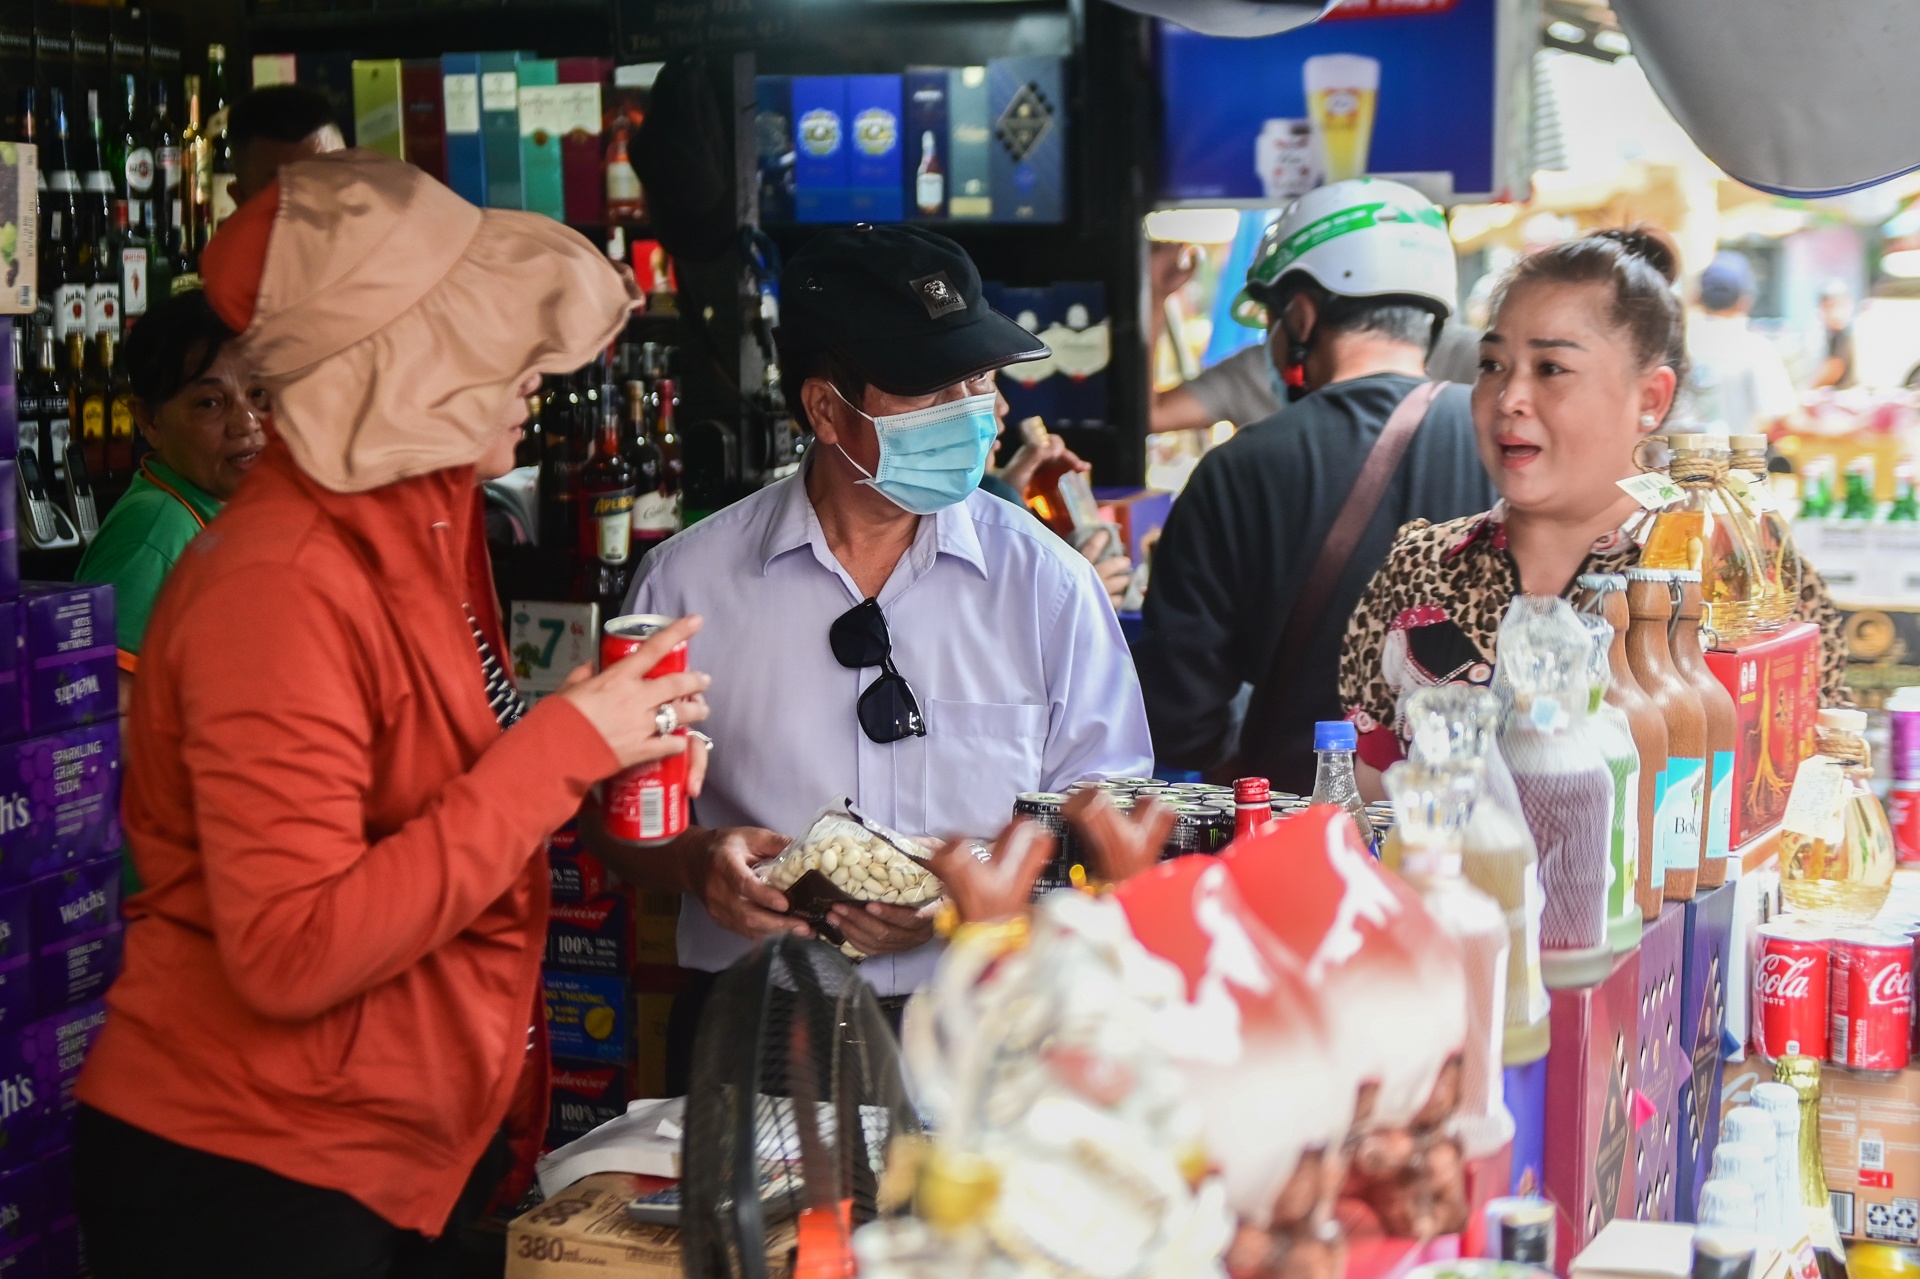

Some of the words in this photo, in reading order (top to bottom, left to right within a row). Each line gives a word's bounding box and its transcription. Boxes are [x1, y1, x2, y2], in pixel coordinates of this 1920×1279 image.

[934, 296, 960, 310] VERSACE
[538, 618, 564, 668] 7
[52, 740, 102, 764] SPARKLING
[53, 761, 84, 780] GRAPE
[54, 777, 81, 796] SODA
[58, 888, 106, 927] Welch's
[558, 934, 594, 956] 100%
[55, 1009, 107, 1043] SPARKLING
[56, 1031, 90, 1058] GRAPE
[560, 1103, 596, 1124] 100%
